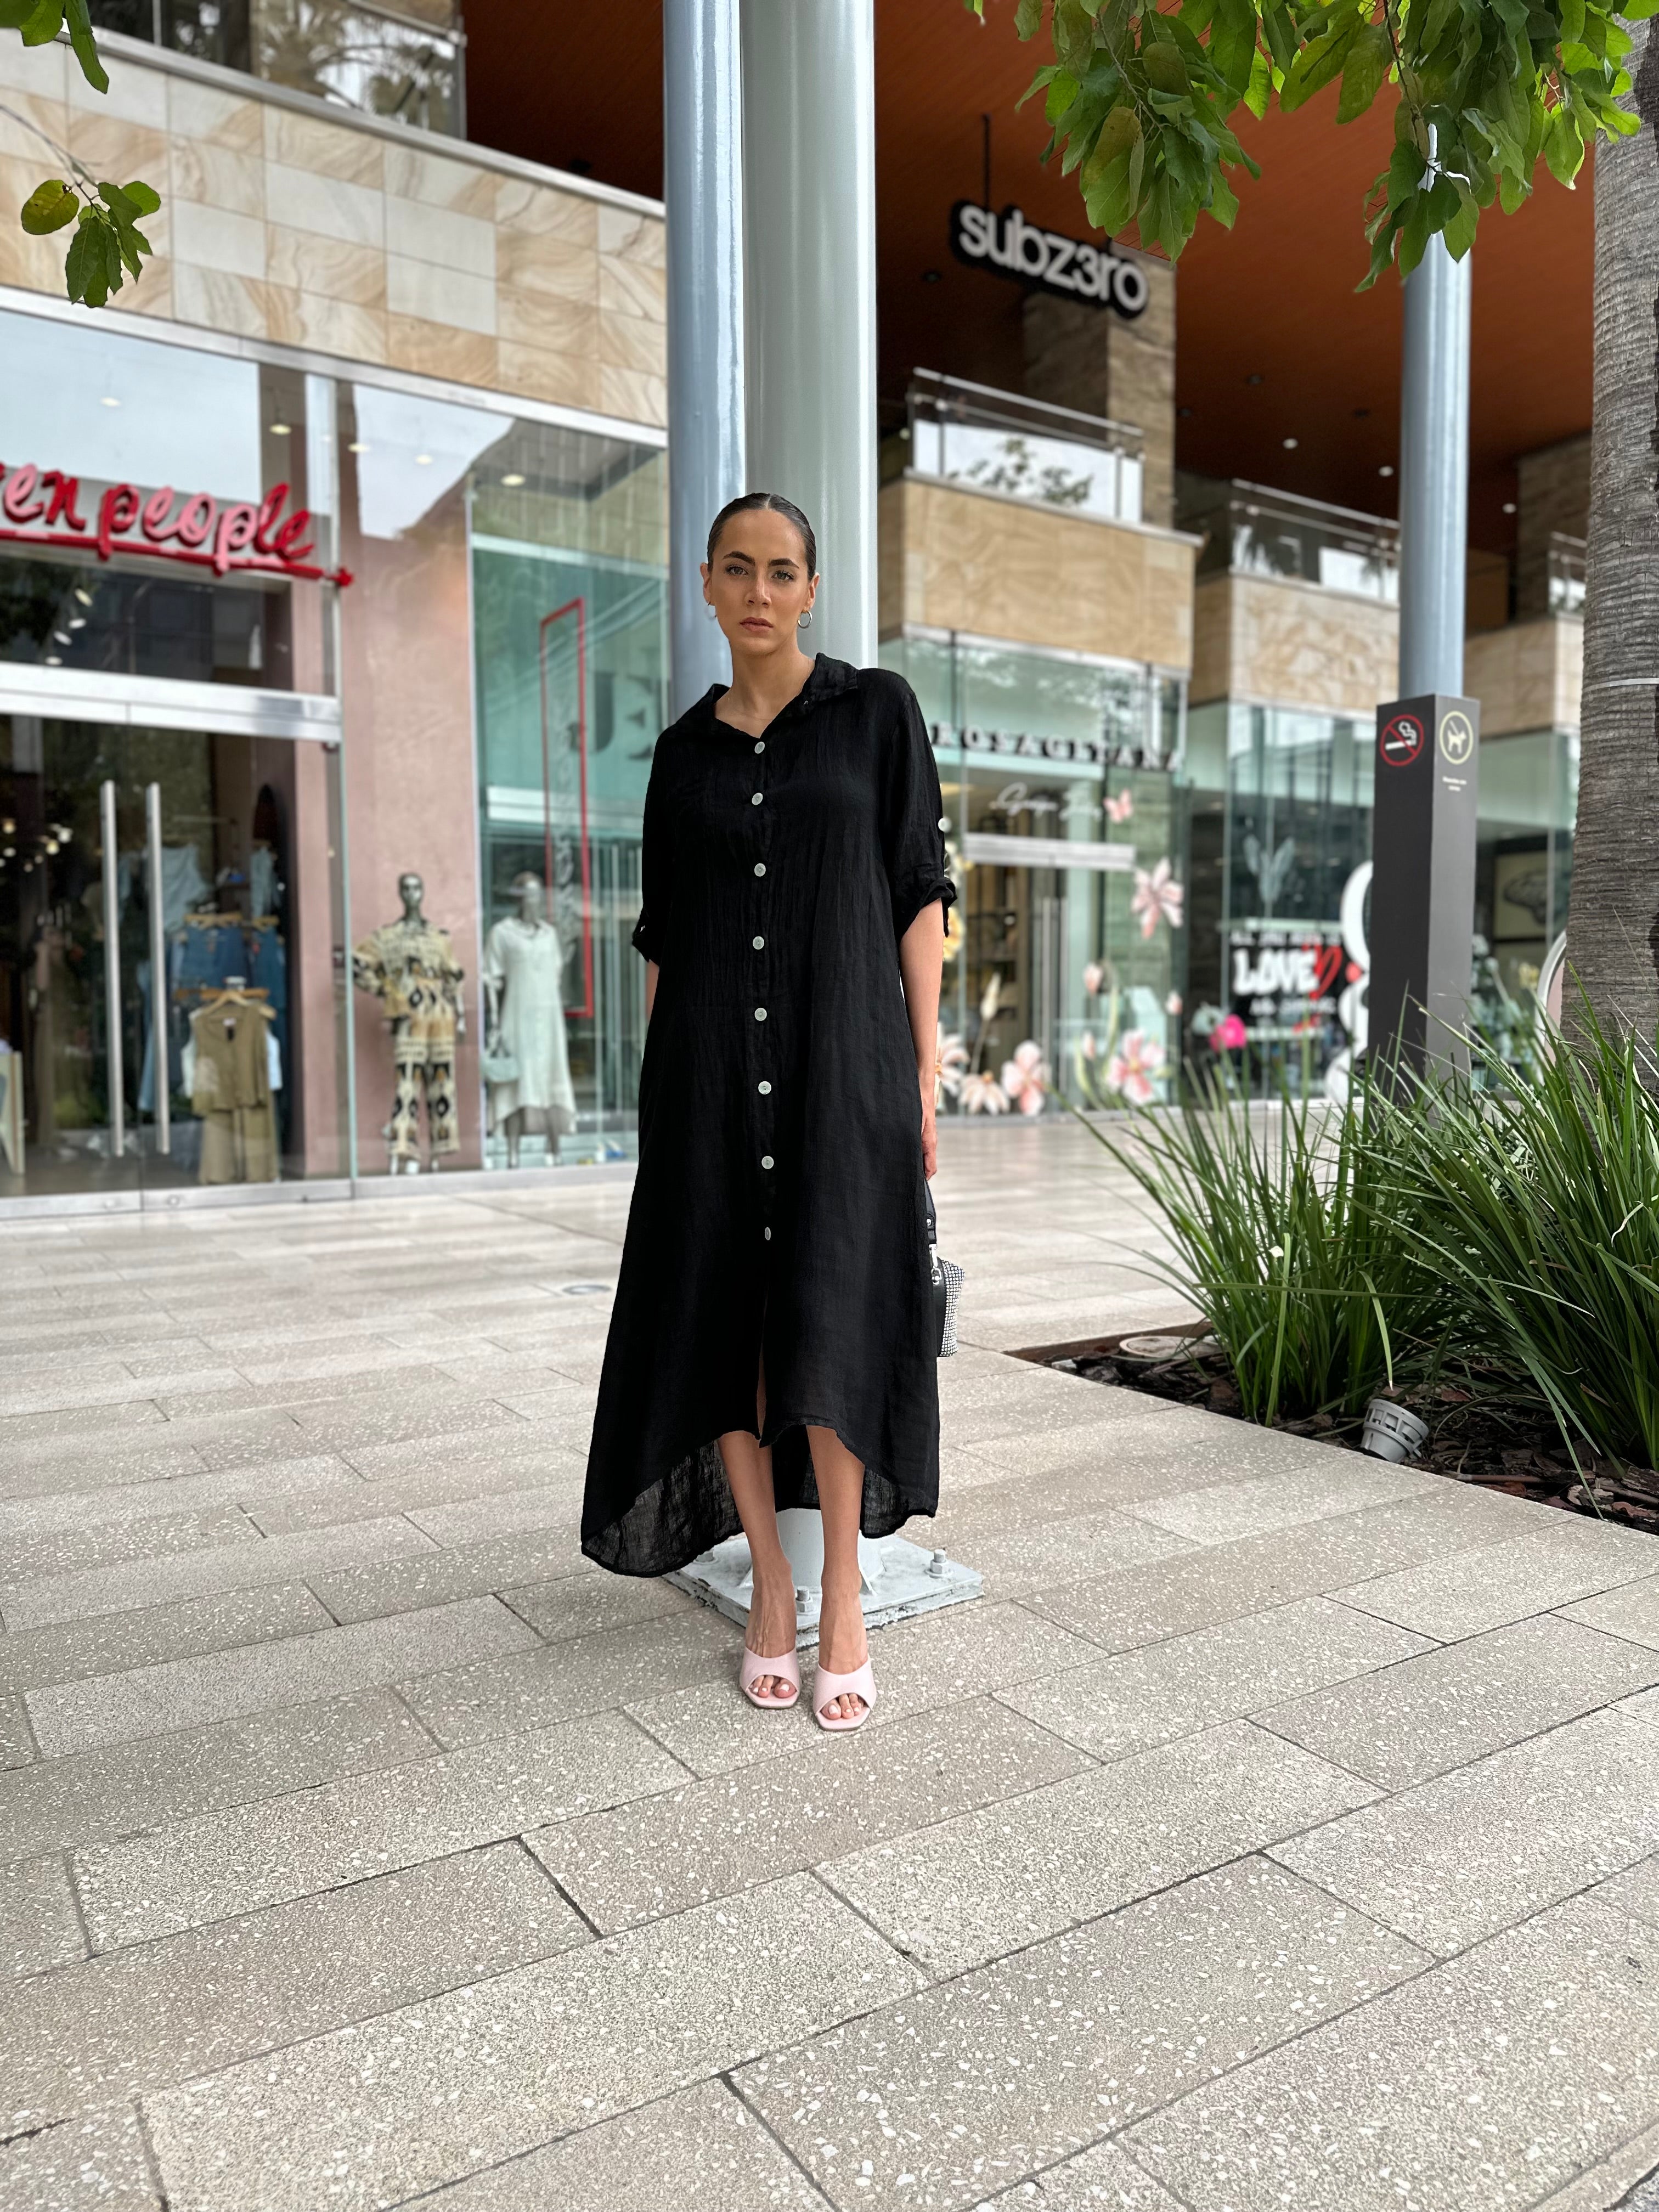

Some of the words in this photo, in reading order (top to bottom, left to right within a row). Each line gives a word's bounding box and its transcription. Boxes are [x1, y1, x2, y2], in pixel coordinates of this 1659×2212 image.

[959, 205, 1148, 311] subz3ro
[0, 463, 86, 530] en
[98, 482, 314, 577] people
[1233, 948, 1319, 996] LOVE
